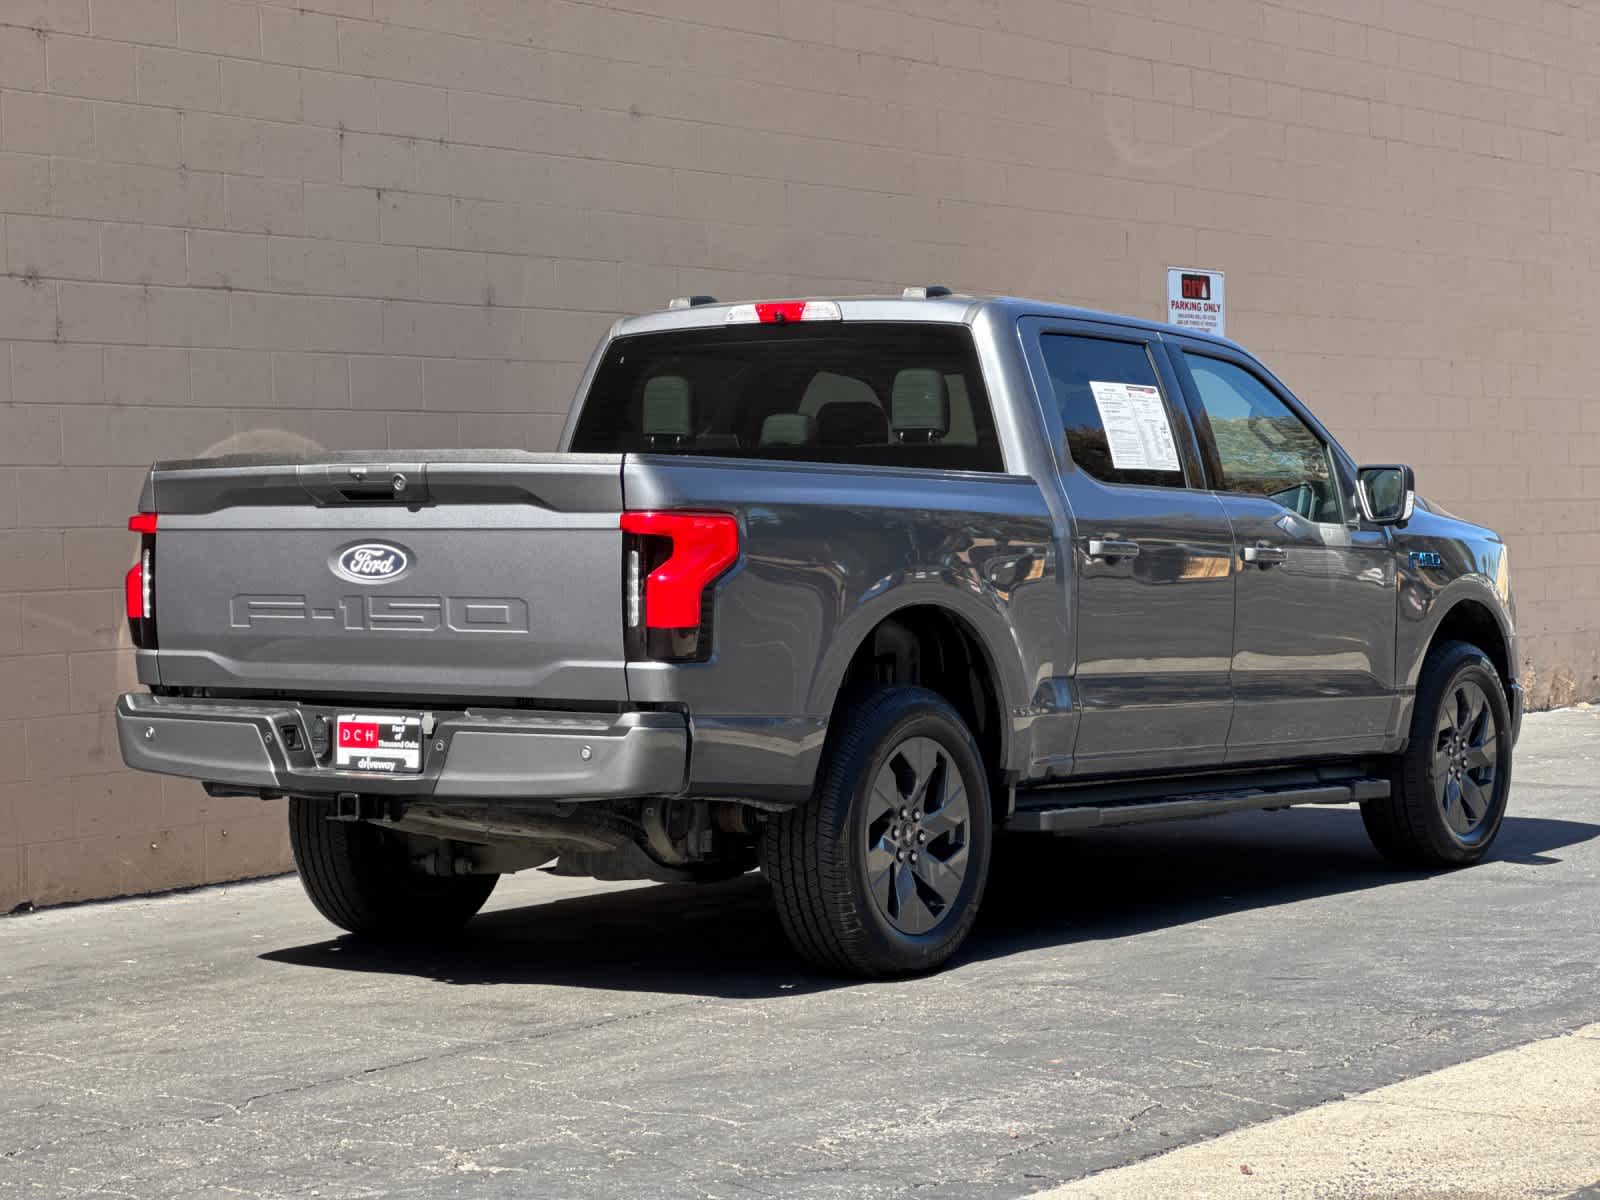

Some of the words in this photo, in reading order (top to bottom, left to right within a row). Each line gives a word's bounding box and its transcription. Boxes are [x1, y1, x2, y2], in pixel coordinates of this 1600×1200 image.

[1171, 300, 1201, 312] PARKING
[1203, 303, 1221, 313] ONLY
[350, 549, 395, 574] Ford
[230, 593, 529, 634] F-150
[394, 733, 402, 741] of
[357, 756, 396, 772] driveway
